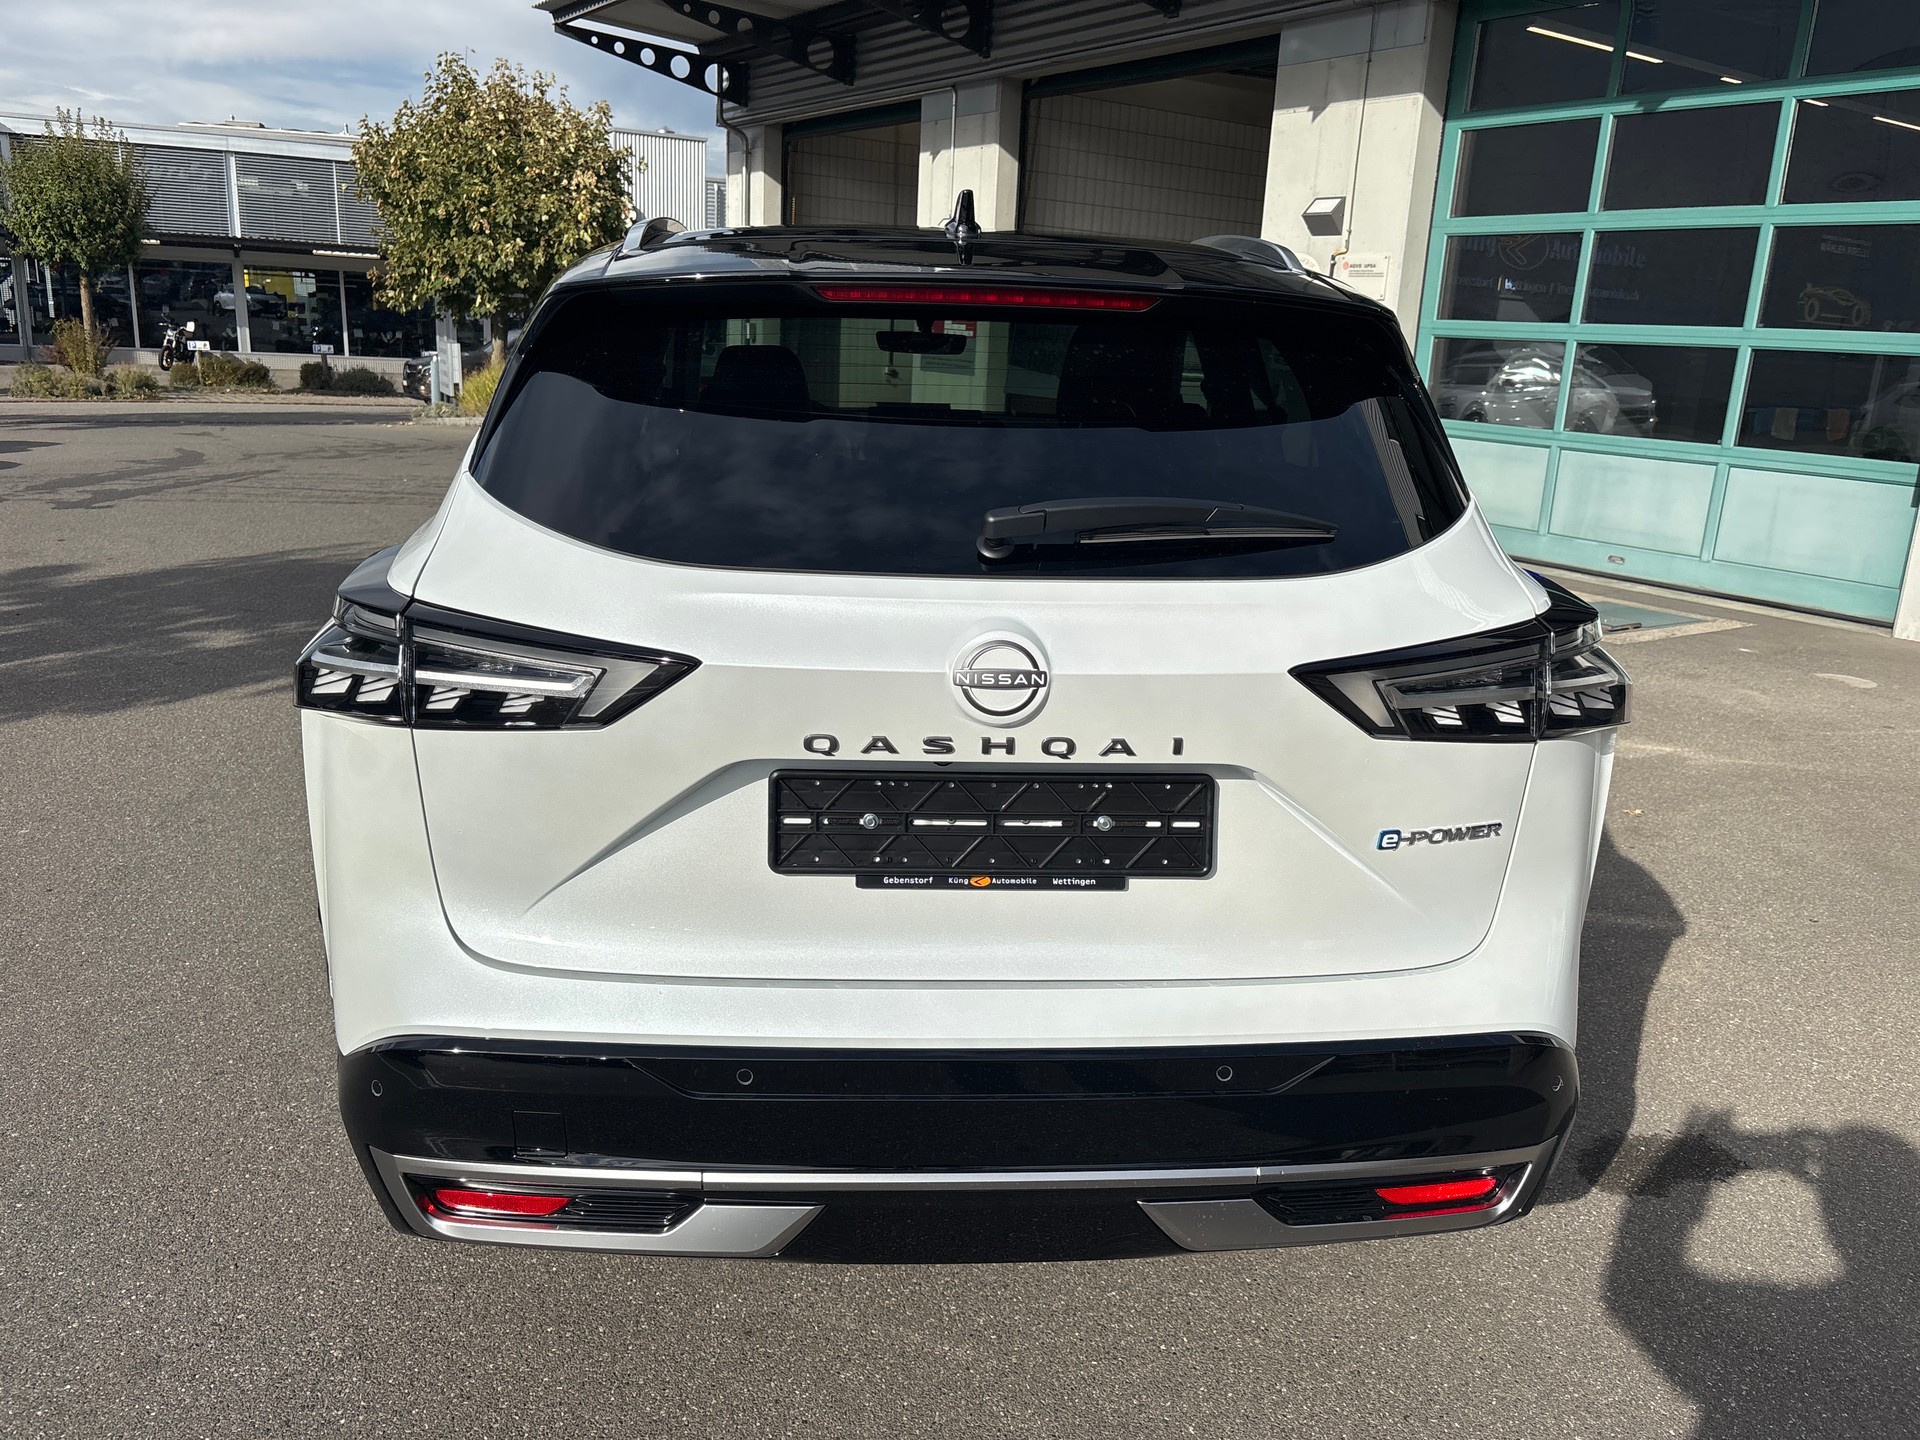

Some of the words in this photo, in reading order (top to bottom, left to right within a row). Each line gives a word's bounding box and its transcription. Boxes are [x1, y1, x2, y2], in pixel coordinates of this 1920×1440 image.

[955, 671, 1046, 687] NISSAN
[803, 734, 1184, 760] QASHQAI
[1377, 822, 1502, 850] e-POWER
[883, 876, 933, 884] Gebenstorf
[948, 877, 969, 885] Küng
[992, 877, 1037, 885] Automobile
[1053, 878, 1096, 886] Wettingen
